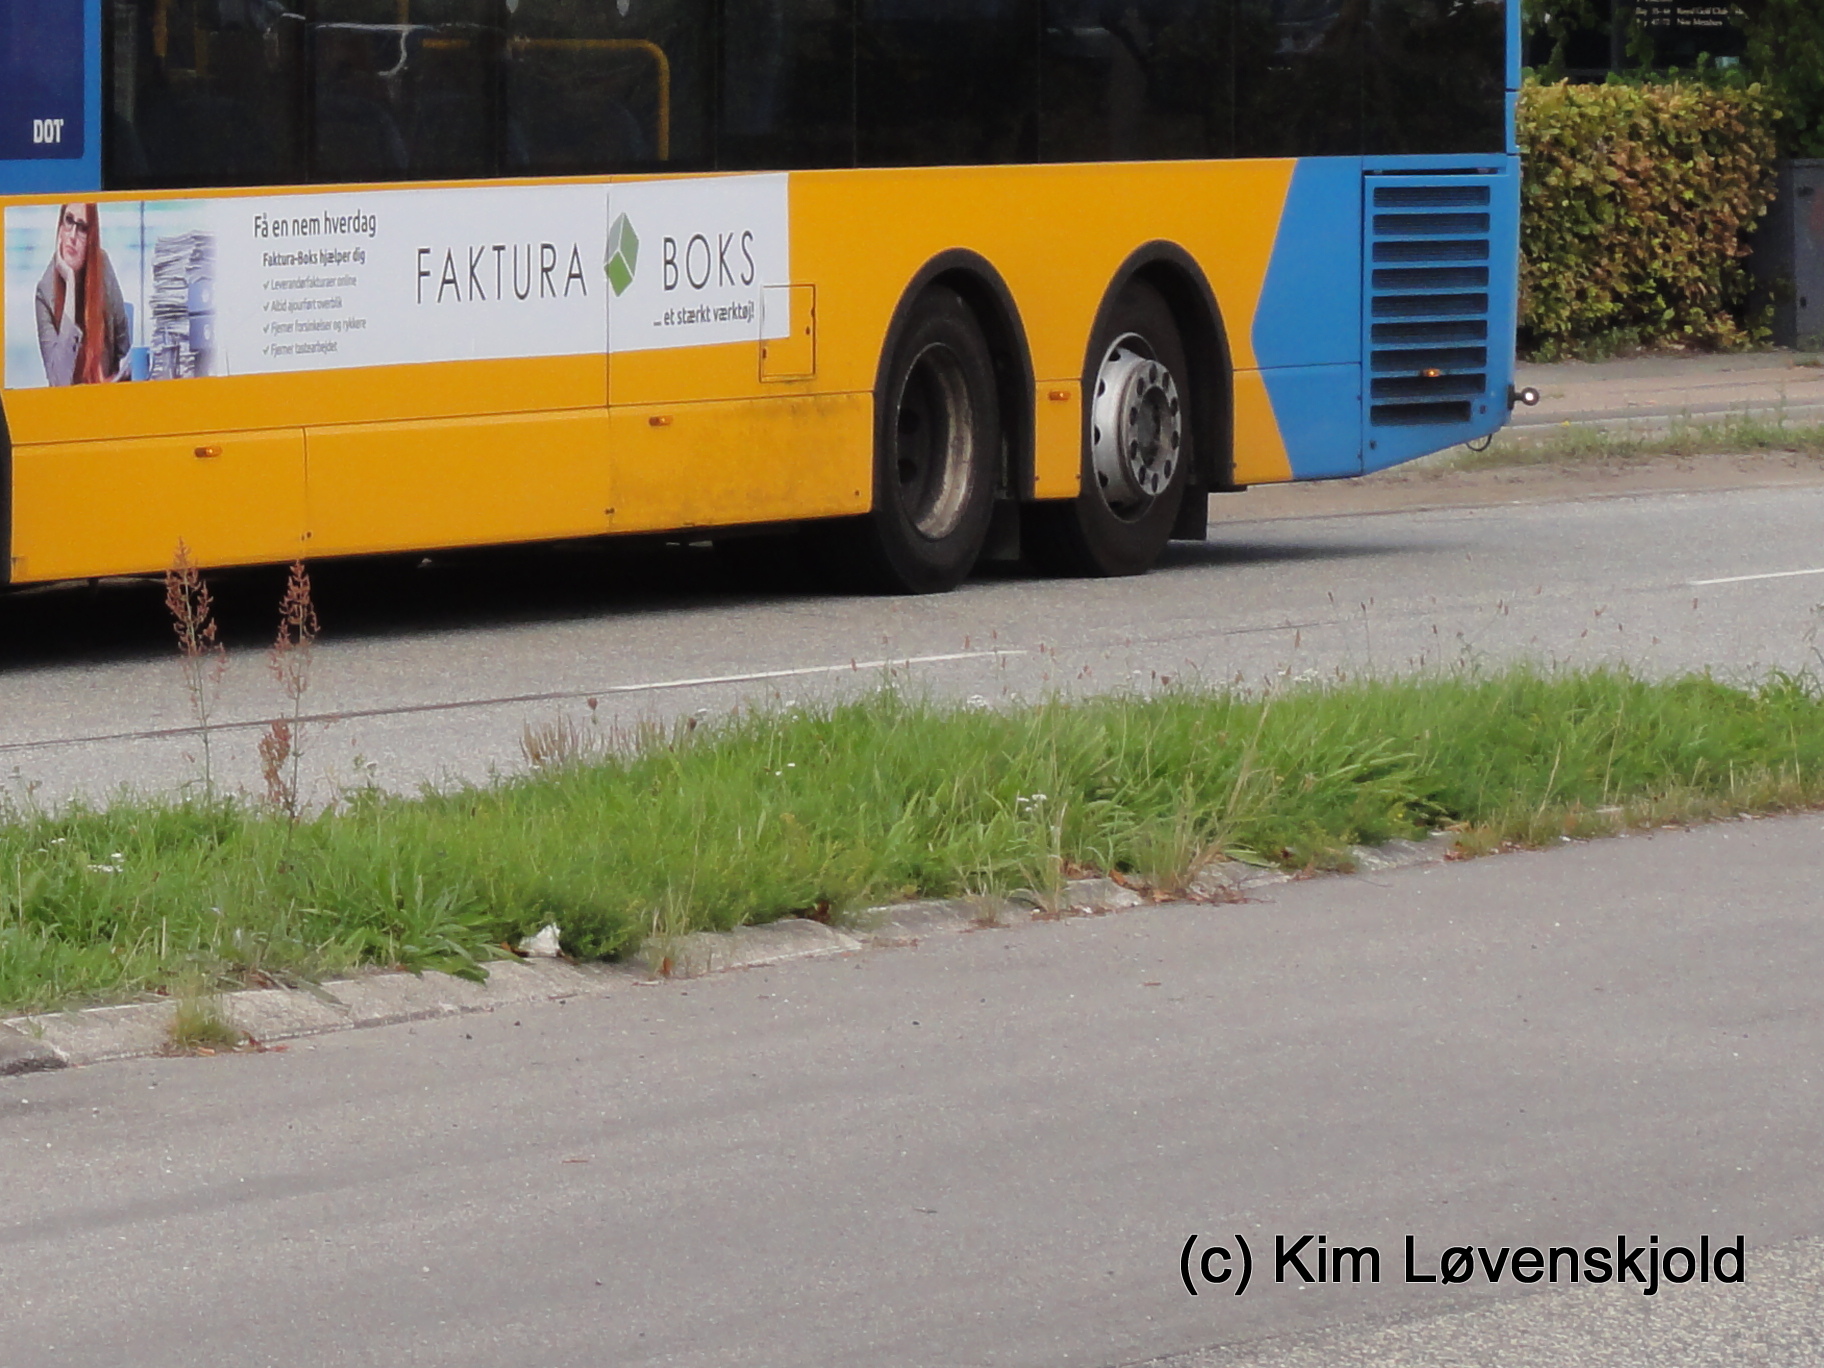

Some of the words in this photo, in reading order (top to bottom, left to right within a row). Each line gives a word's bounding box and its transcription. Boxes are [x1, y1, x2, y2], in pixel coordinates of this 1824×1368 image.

[33, 119, 64, 143] DOT
[254, 212, 268, 238] Få
[272, 218, 289, 237] en
[292, 216, 320, 236] nem
[324, 209, 376, 238] hverdag
[263, 249, 318, 267] Faktura-Boks
[319, 248, 351, 266] hjælper
[352, 247, 366, 265] dig
[417, 243, 587, 304] FAKTURA
[663, 230, 755, 291] BOKS
[337, 274, 357, 287] online
[664, 310, 676, 327] et
[677, 303, 711, 325] stærkt
[713, 300, 755, 324] værktøj!
[333, 320, 342, 333] og
